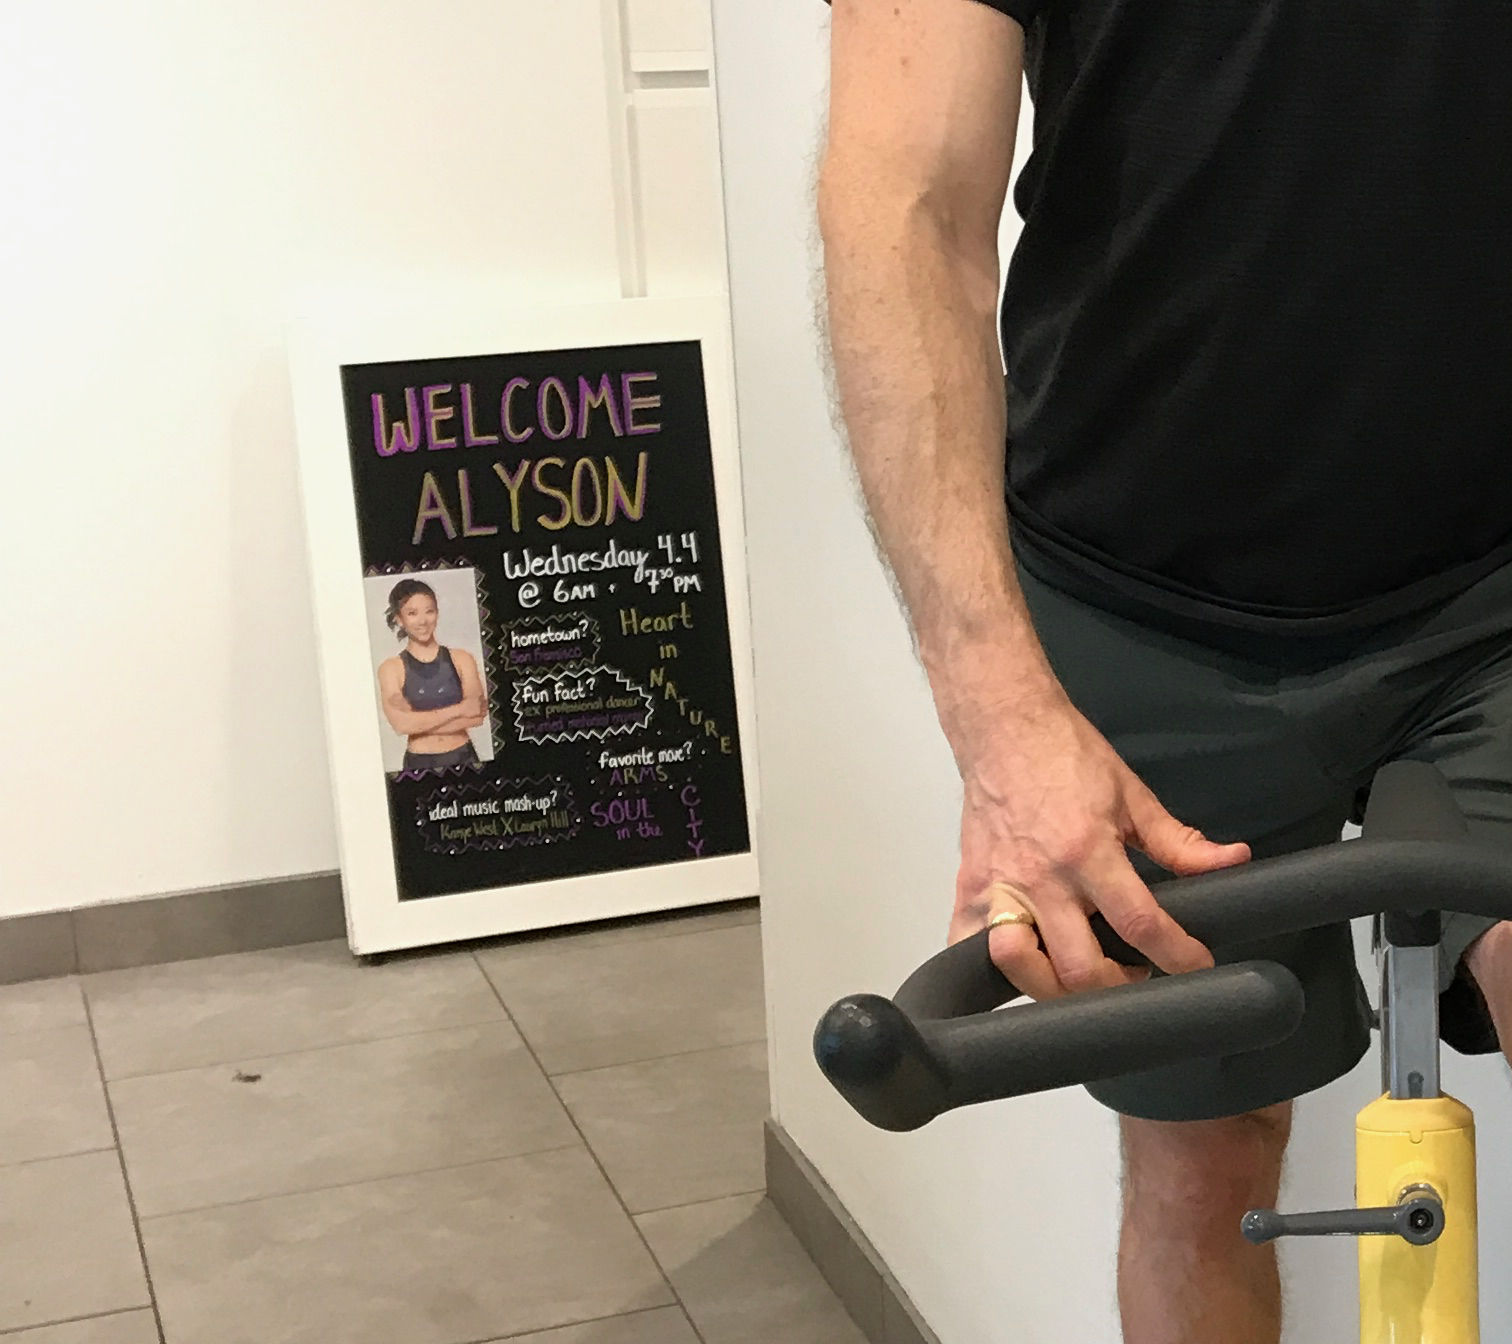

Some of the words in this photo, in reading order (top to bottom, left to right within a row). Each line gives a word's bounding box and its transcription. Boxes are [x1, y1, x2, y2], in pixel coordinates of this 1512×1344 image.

[372, 372, 661, 457] WELCOME
[412, 452, 648, 545] ALYSON
[503, 538, 649, 584] Wednesday
[657, 530, 698, 564] 4.4
[518, 581, 541, 608] @
[553, 579, 596, 603] 6AM
[619, 601, 693, 636] Heart
[510, 619, 589, 649] hometown?
[659, 642, 678, 659] in
[522, 685, 550, 704] fun
[554, 677, 596, 702] fact?
[598, 746, 655, 769] favorite
[609, 765, 669, 786] ARMS
[428, 799, 458, 821] ideal
[462, 798, 500, 816] music
[590, 798, 655, 828] SOUL
[616, 827, 631, 840] in
[636, 821, 664, 839] the
